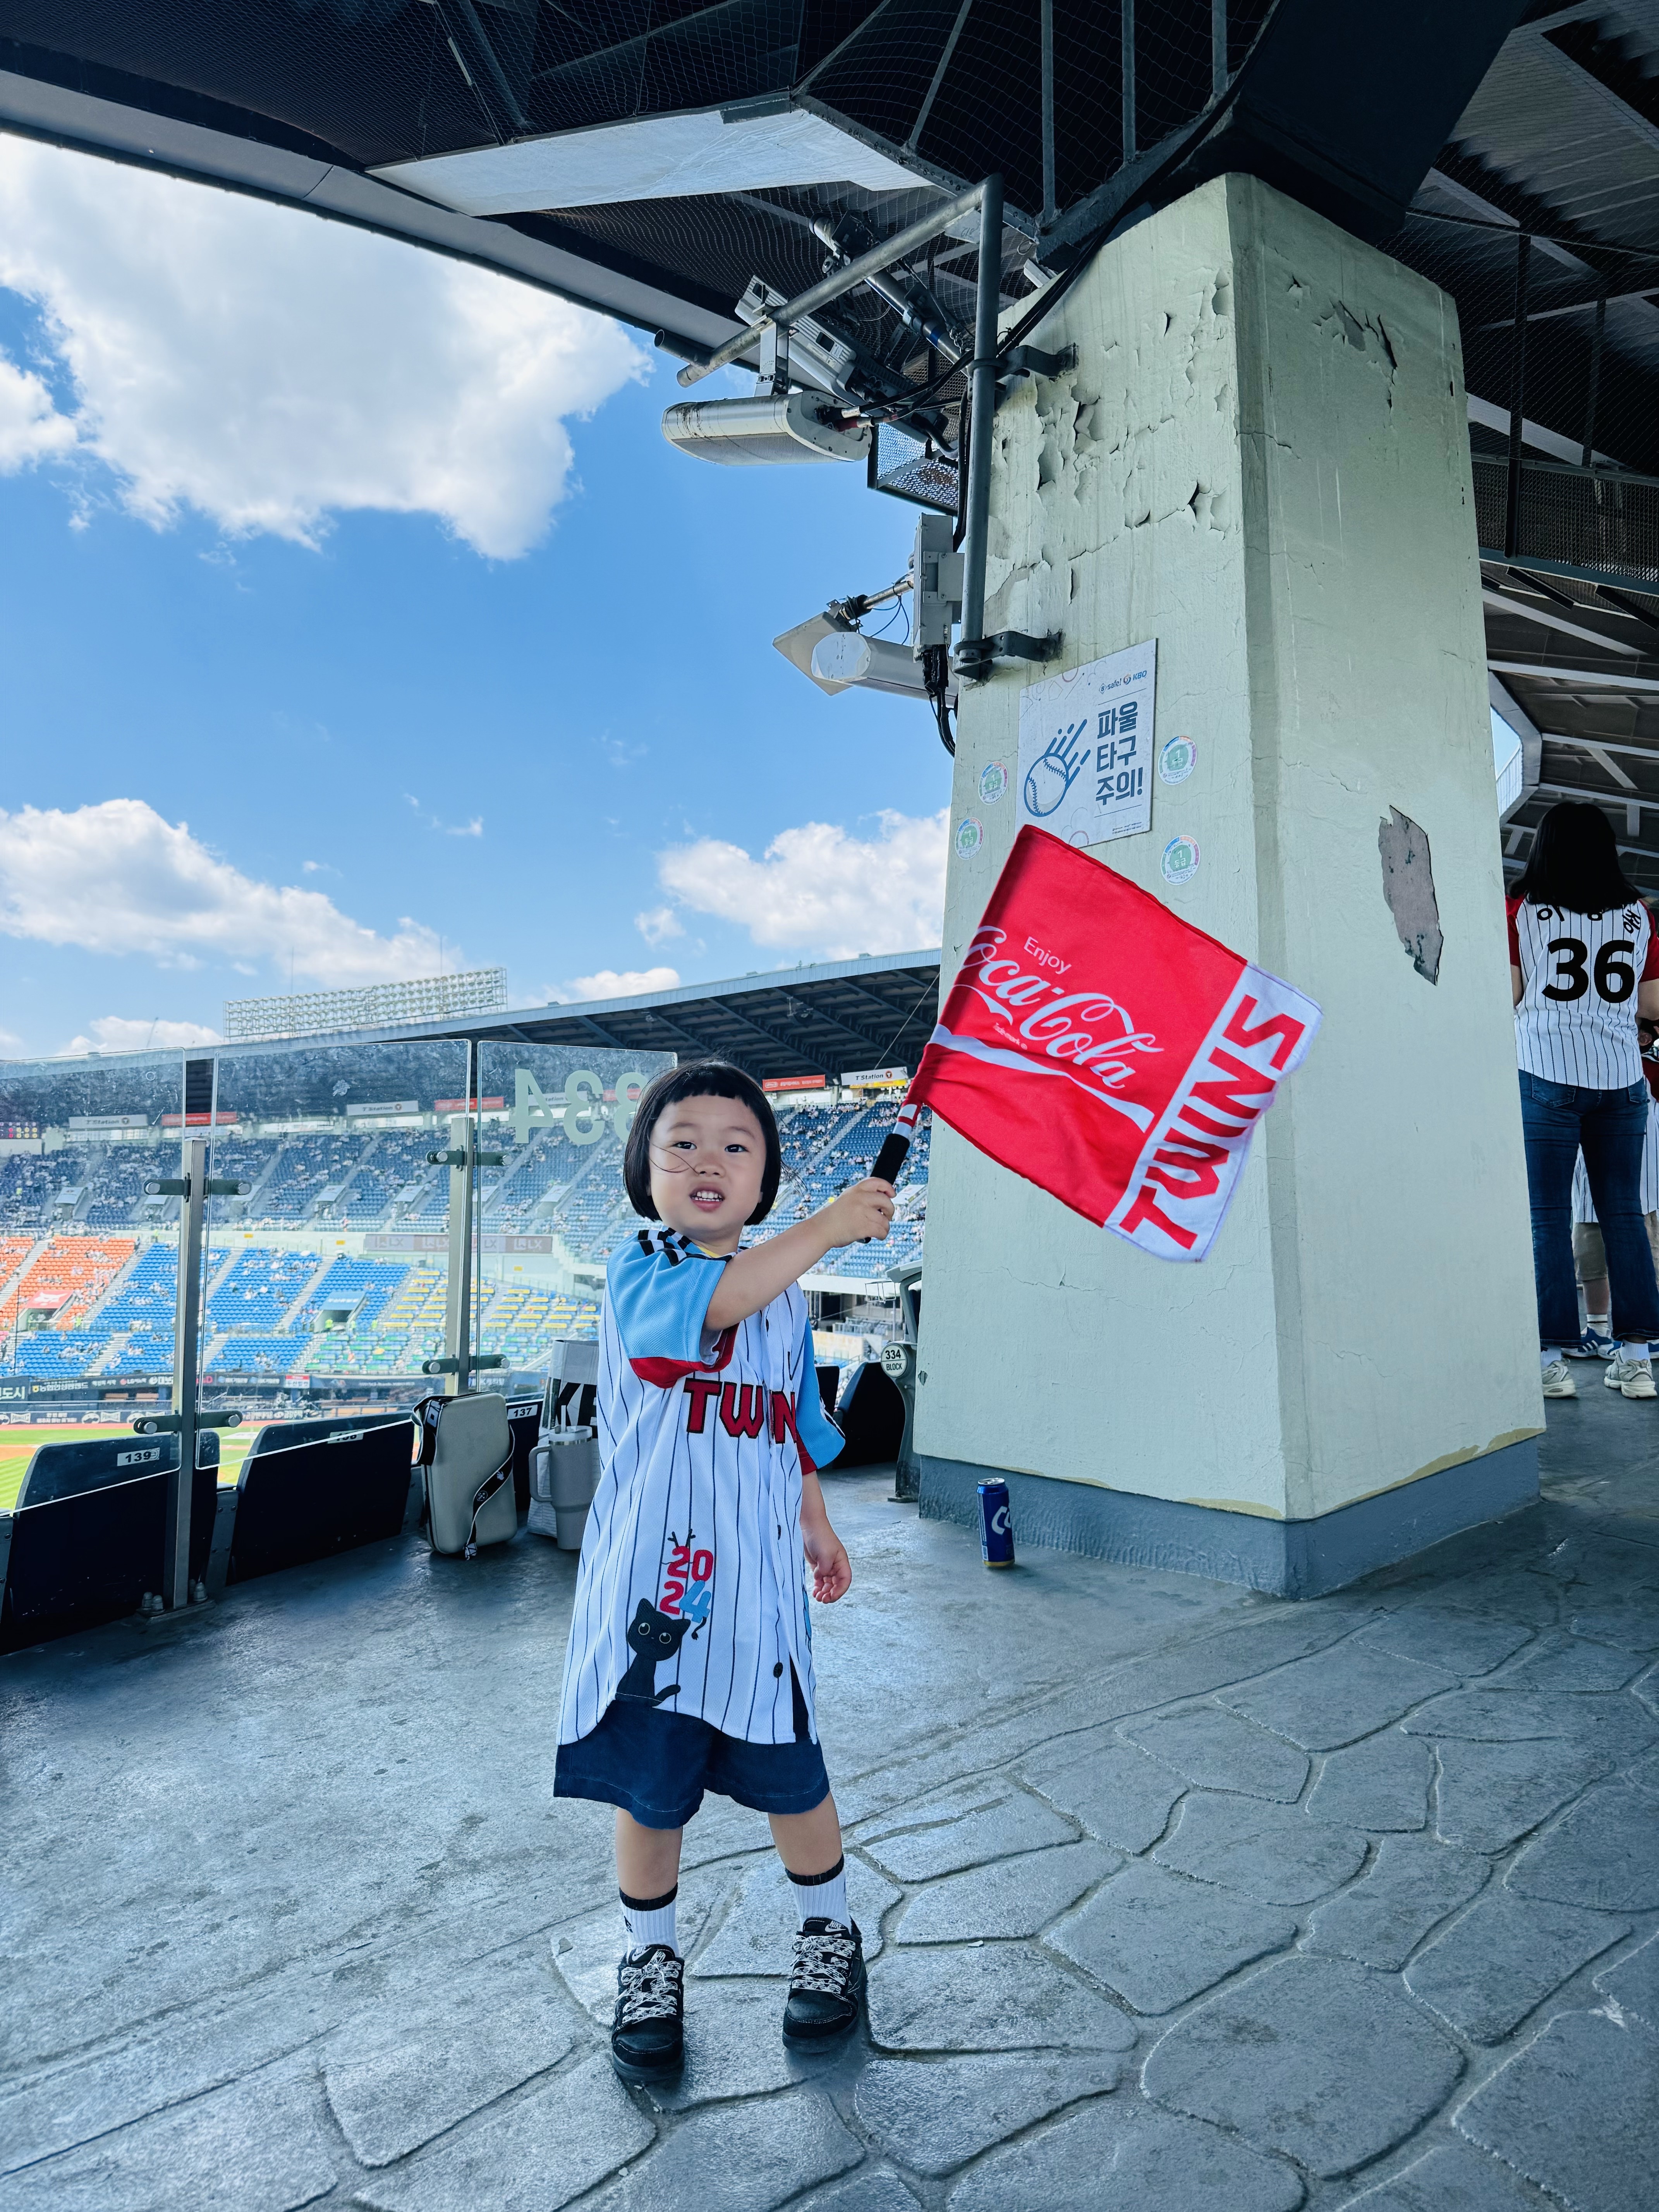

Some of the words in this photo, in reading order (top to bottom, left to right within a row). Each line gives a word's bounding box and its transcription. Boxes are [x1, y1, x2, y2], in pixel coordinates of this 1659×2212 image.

[1107, 678, 1121, 690] safe!
[1133, 670, 1147, 680] KBO
[1097, 701, 1138, 739] 파울
[1096, 735, 1137, 773] 타구
[1176, 749, 1180, 758] 1
[1095, 767, 1143, 806] 주의!
[1178, 850, 1182, 858] 1
[1175, 858, 1186, 868] 등급
[1023, 936, 1072, 975] Enjoy
[1541, 938, 1635, 1003] 36
[1118, 994, 1306, 1250] TWINS
[885, 1349, 901, 1360] 334
[886, 1363, 903, 1371] BLOCK
[0, 1386, 25, 1400] 도시
[514, 1407, 532, 1417] 137
[125, 1451, 151, 1463] 139
[667, 1546, 714, 1582] 20
[659, 1580, 712, 1623] 24
[829, 1920, 843, 1929] NIKE
[635, 1945, 647, 1955] NIKE
